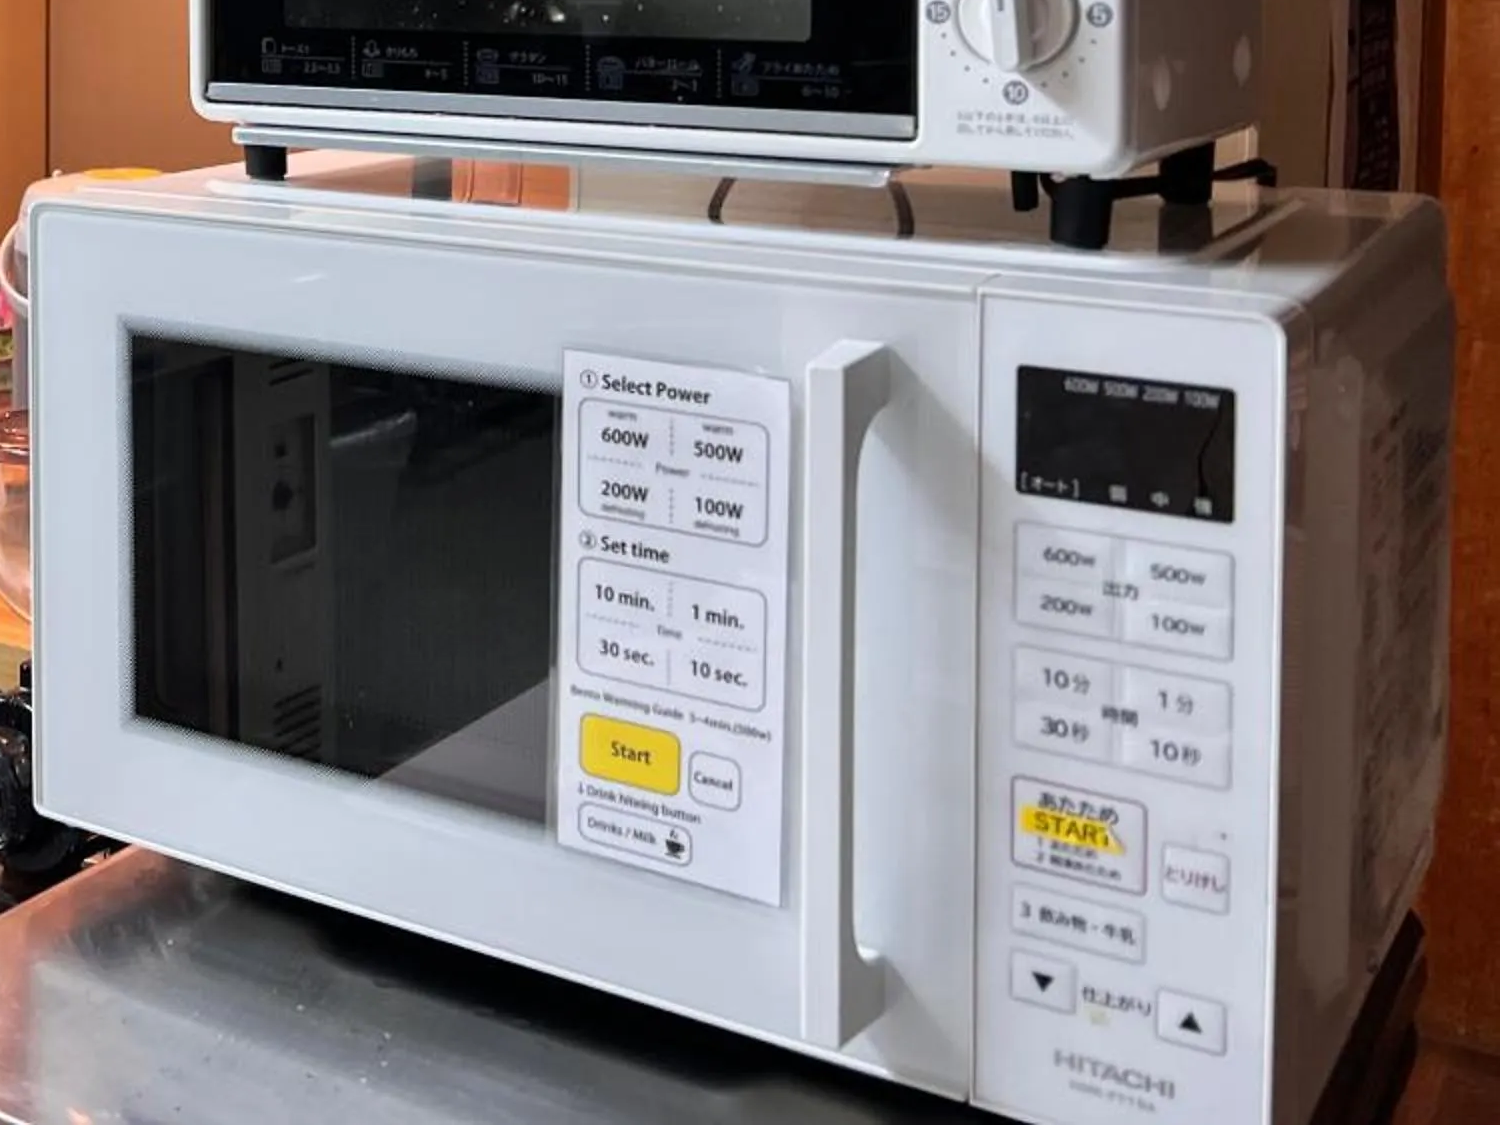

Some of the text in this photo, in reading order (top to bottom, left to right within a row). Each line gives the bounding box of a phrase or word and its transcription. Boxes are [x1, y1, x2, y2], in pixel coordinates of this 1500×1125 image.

[601, 373, 651, 396] Select
[656, 382, 711, 404] Power
[601, 426, 649, 449] 600W
[693, 440, 744, 463] 500W
[655, 462, 690, 477] Power
[601, 480, 649, 503] 200W
[695, 496, 744, 520] 100W
[600, 535, 627, 556] Set
[631, 541, 670, 563] time
[596, 584, 655, 612] 10 min.
[692, 604, 745, 630] 1 min.
[599, 639, 656, 666] 30 sec.
[691, 660, 749, 688] 10 sec.
[610, 740, 652, 765] Start
[693, 771, 734, 791] Cancel
[1053, 1048, 1176, 1100] HITACHI
